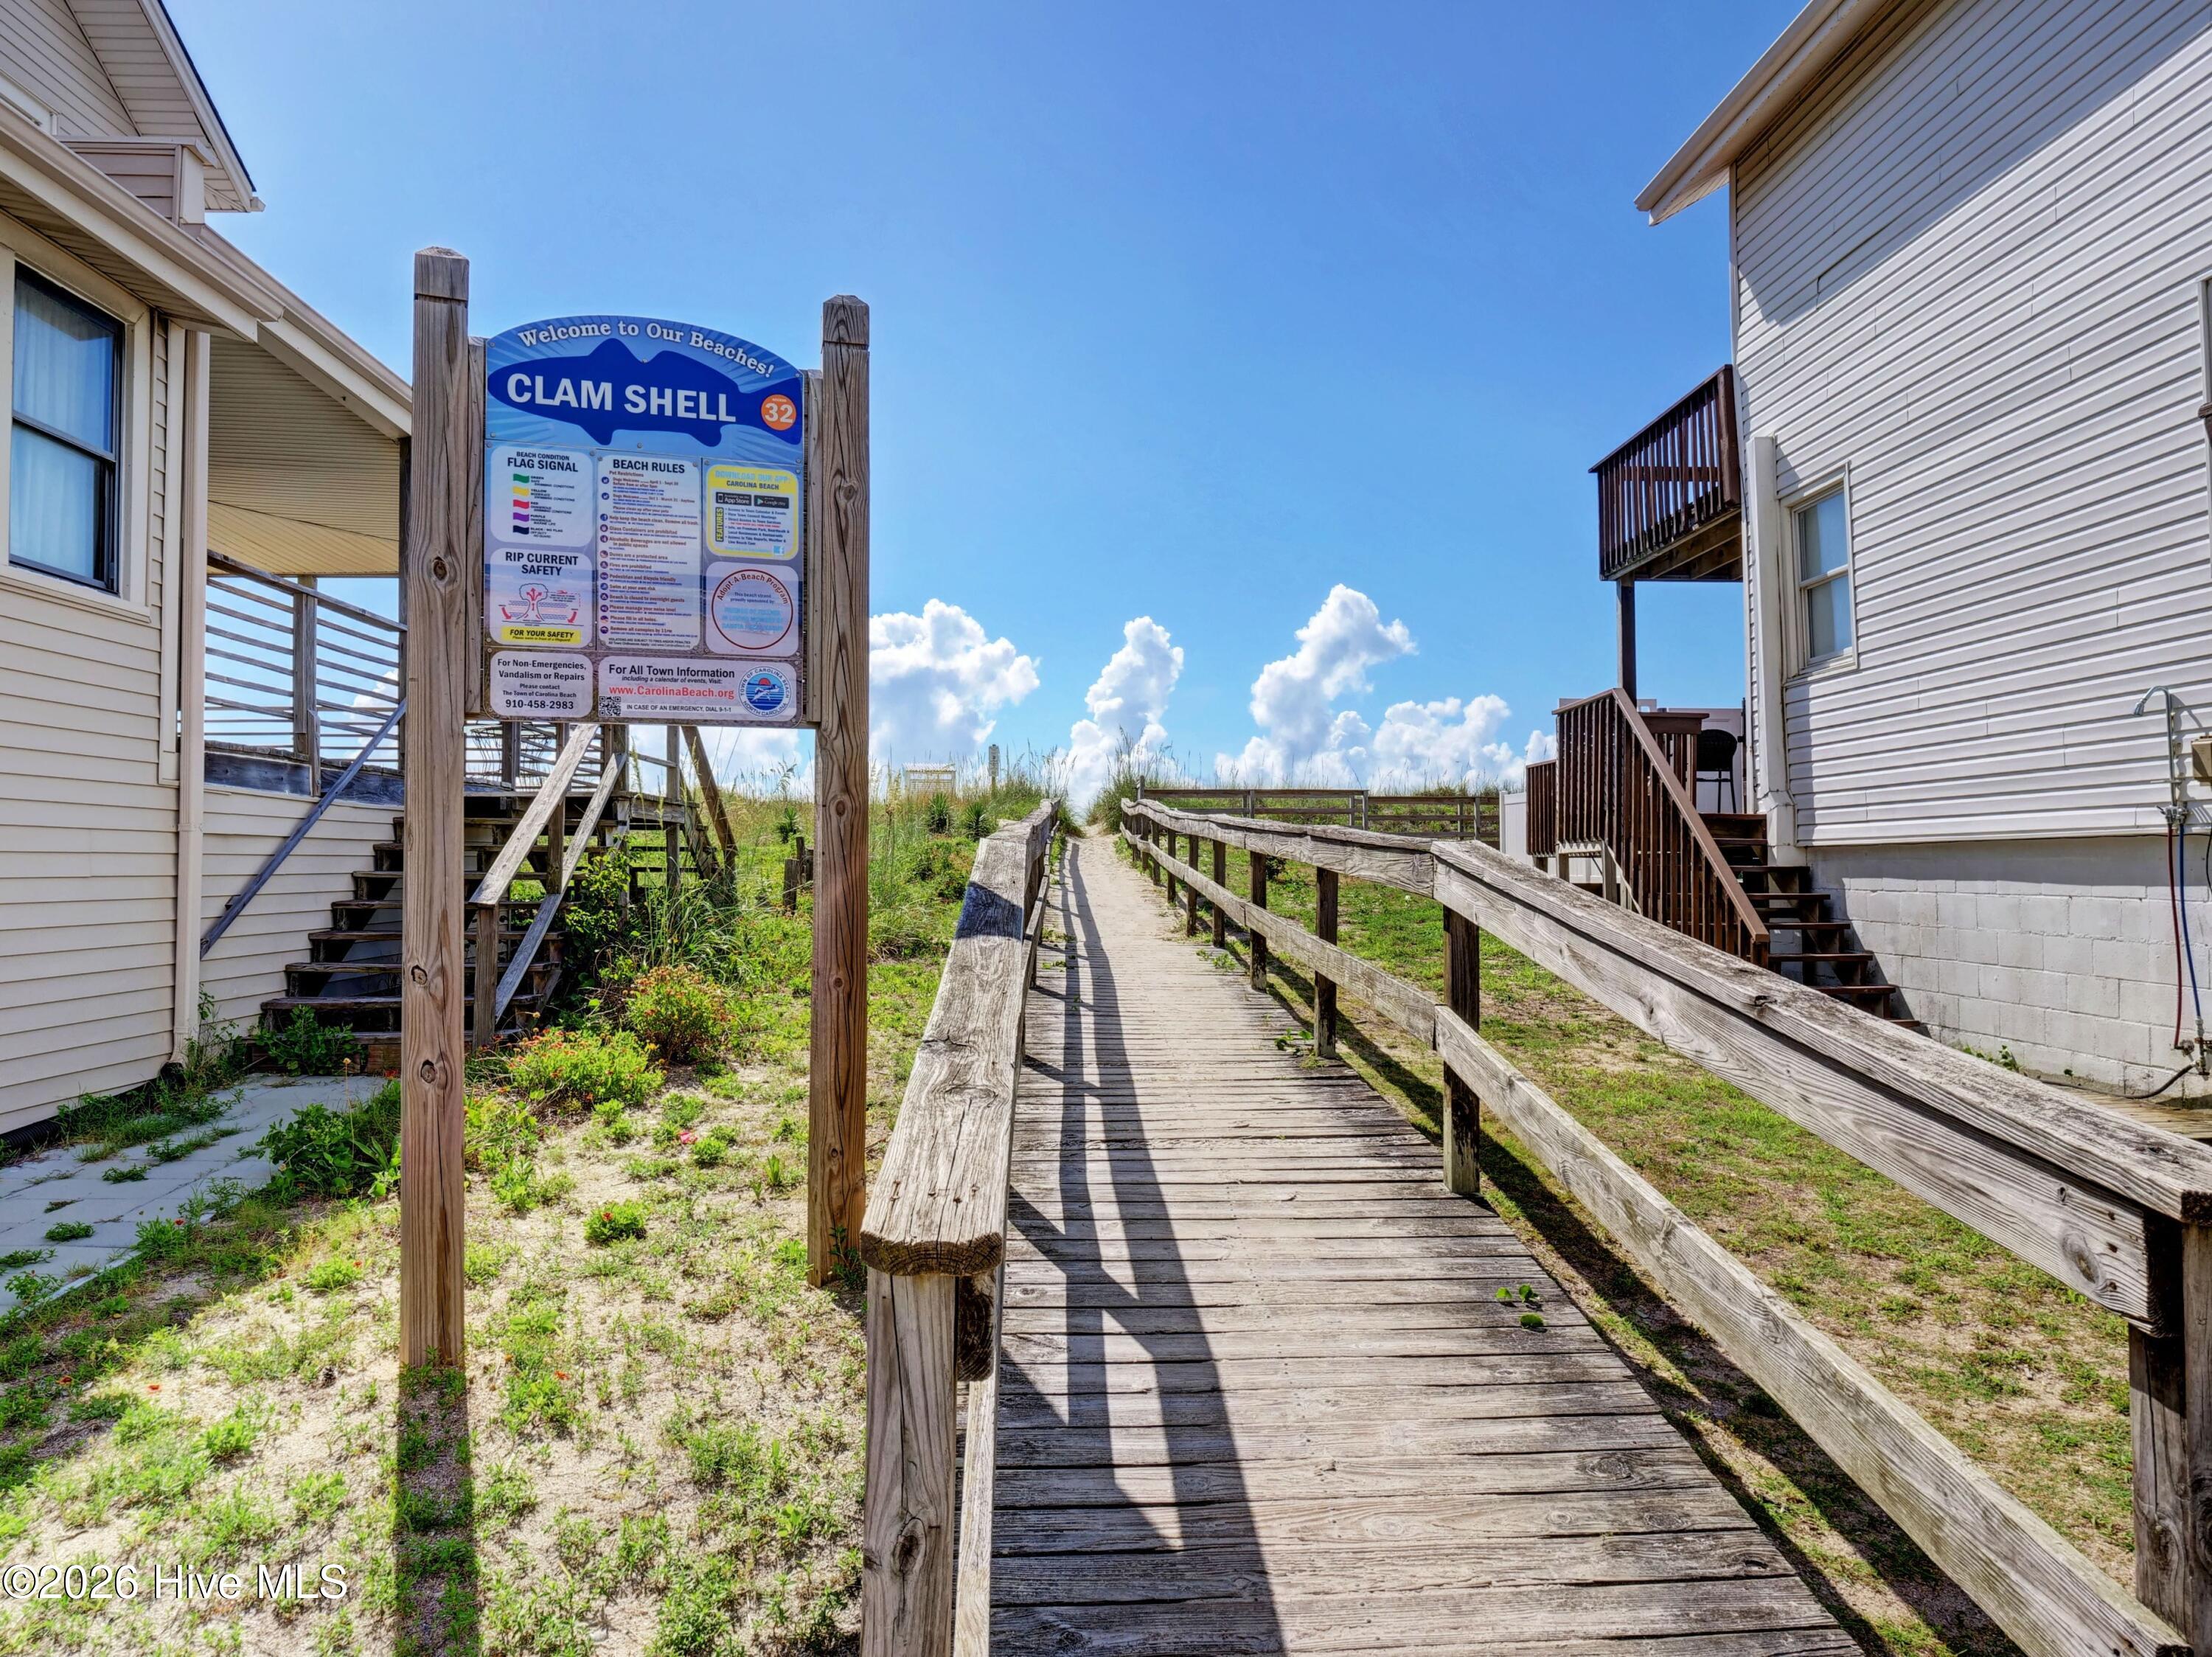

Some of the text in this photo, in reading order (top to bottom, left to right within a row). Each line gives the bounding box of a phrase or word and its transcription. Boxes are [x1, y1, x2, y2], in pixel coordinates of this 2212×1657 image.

[518, 321, 776, 378] Welcome to Our Beaches!
[507, 373, 736, 423] CLAM SHELL
[765, 403, 793, 423] 32
[507, 457, 578, 472] FLAG SIGNAL
[613, 459, 685, 473] BEACH RULES
[506, 552, 578, 566] RIP CURRENT
[522, 564, 562, 576] SAFETY
[717, 574, 788, 604] Adopt-A-Beach Program
[513, 659, 587, 670] Non-Emergencies,
[609, 664, 735, 678] For All Town Information
[498, 670, 541, 678] Vandalism
[554, 673, 585, 681] Repairs
[755, 668, 783, 678] CAROLINA
[609, 685, 734, 700] www.CarolinaBeach.org
[506, 699, 574, 709] 910-458-2983
[743, 701, 788, 716] NORTH CAROLINA
